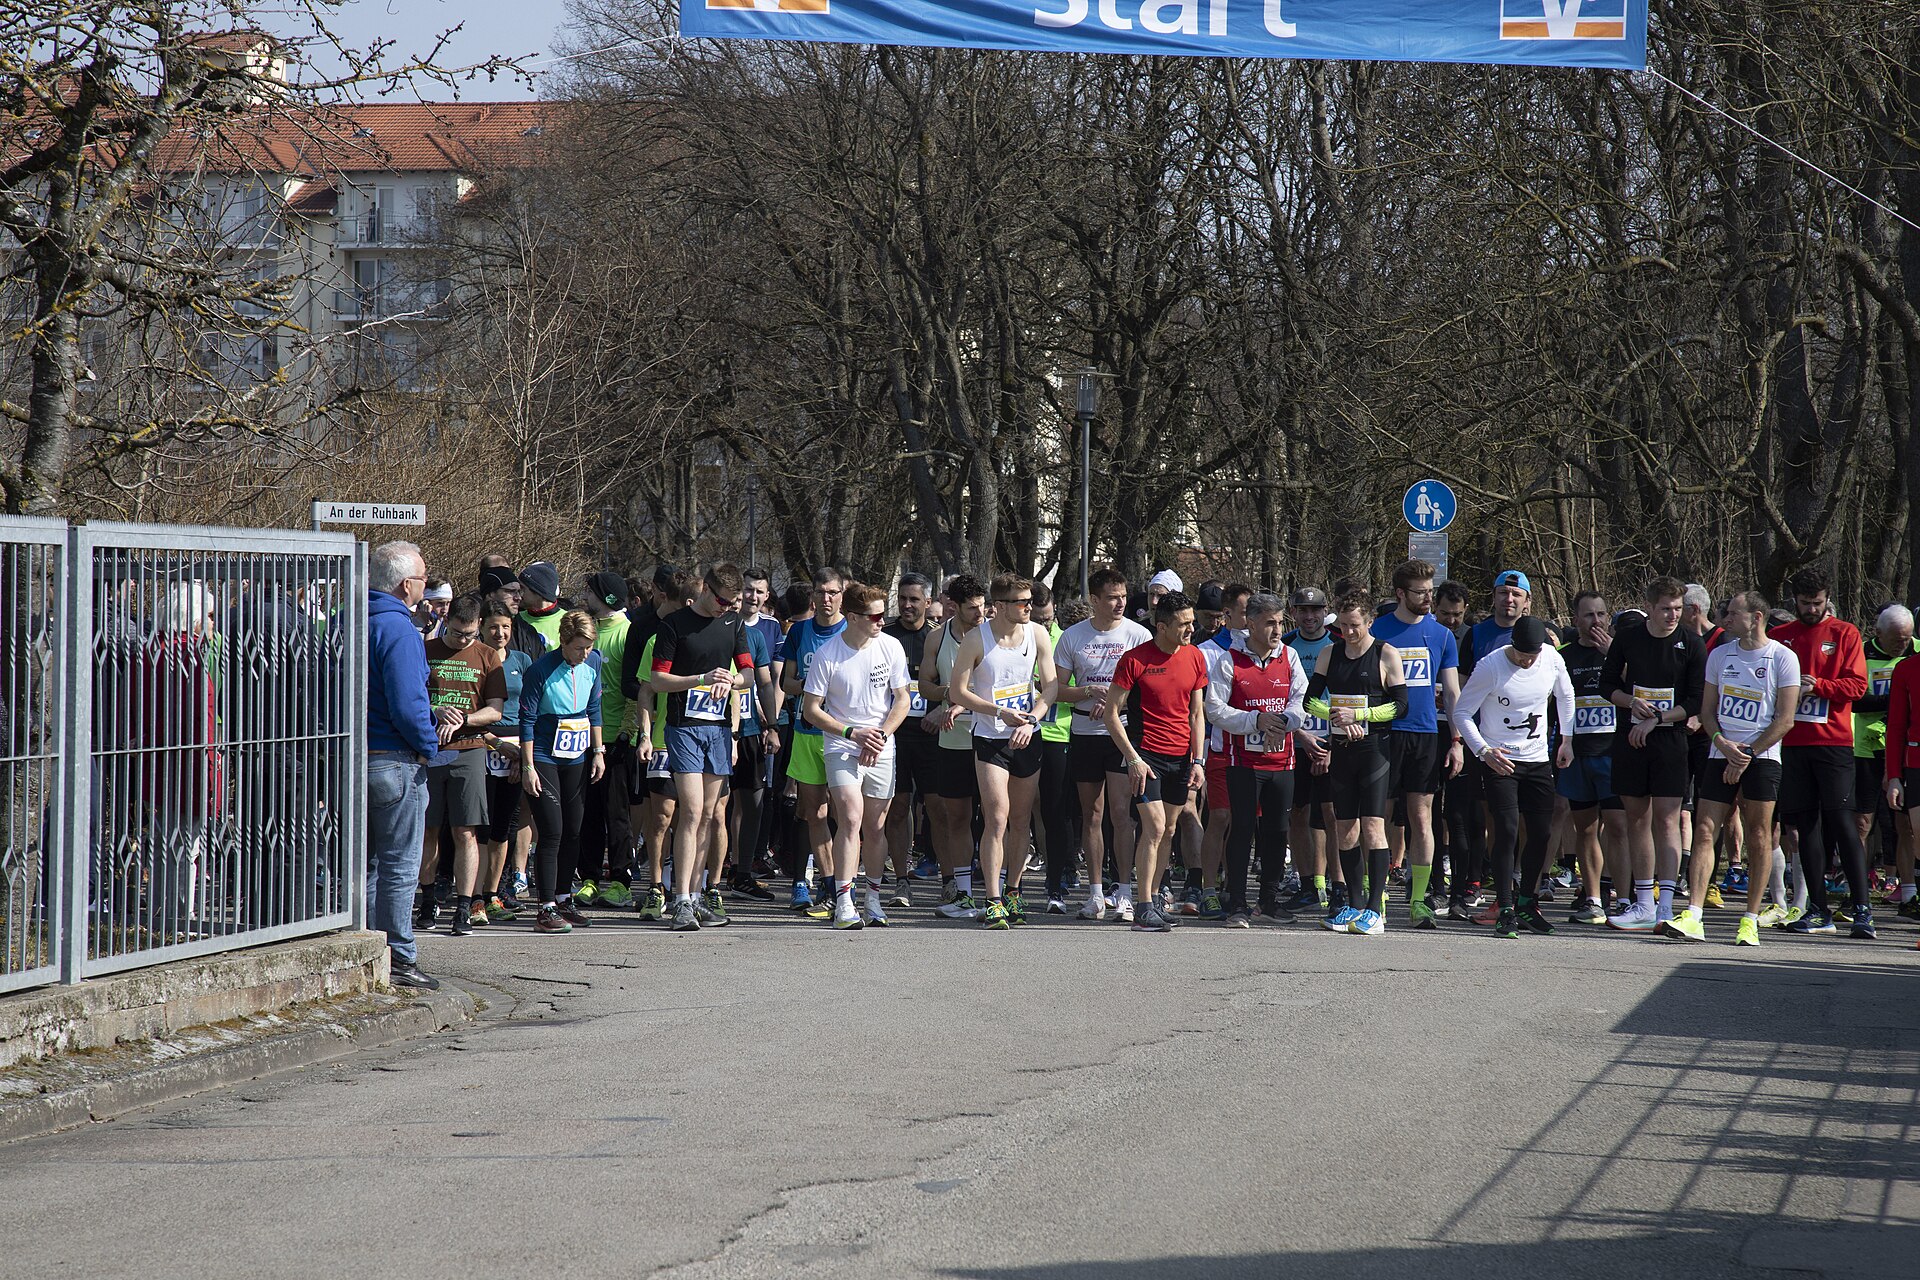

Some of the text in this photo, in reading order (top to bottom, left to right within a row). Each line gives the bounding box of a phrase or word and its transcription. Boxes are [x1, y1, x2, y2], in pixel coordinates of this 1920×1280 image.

[329, 505, 418, 520] An der Ruhbank
[1092, 642, 1124, 650] WEINBERG
[430, 665, 481, 675] OMMERBIATHLON
[1403, 660, 1426, 679] 72
[1245, 698, 1286, 707] HEUNISCH
[1265, 704, 1286, 713] GUSS
[1723, 696, 1758, 721] 960
[1795, 696, 1821, 716] 61
[1577, 708, 1612, 727] 968
[559, 731, 587, 752] 818
[489, 750, 511, 771] 89
